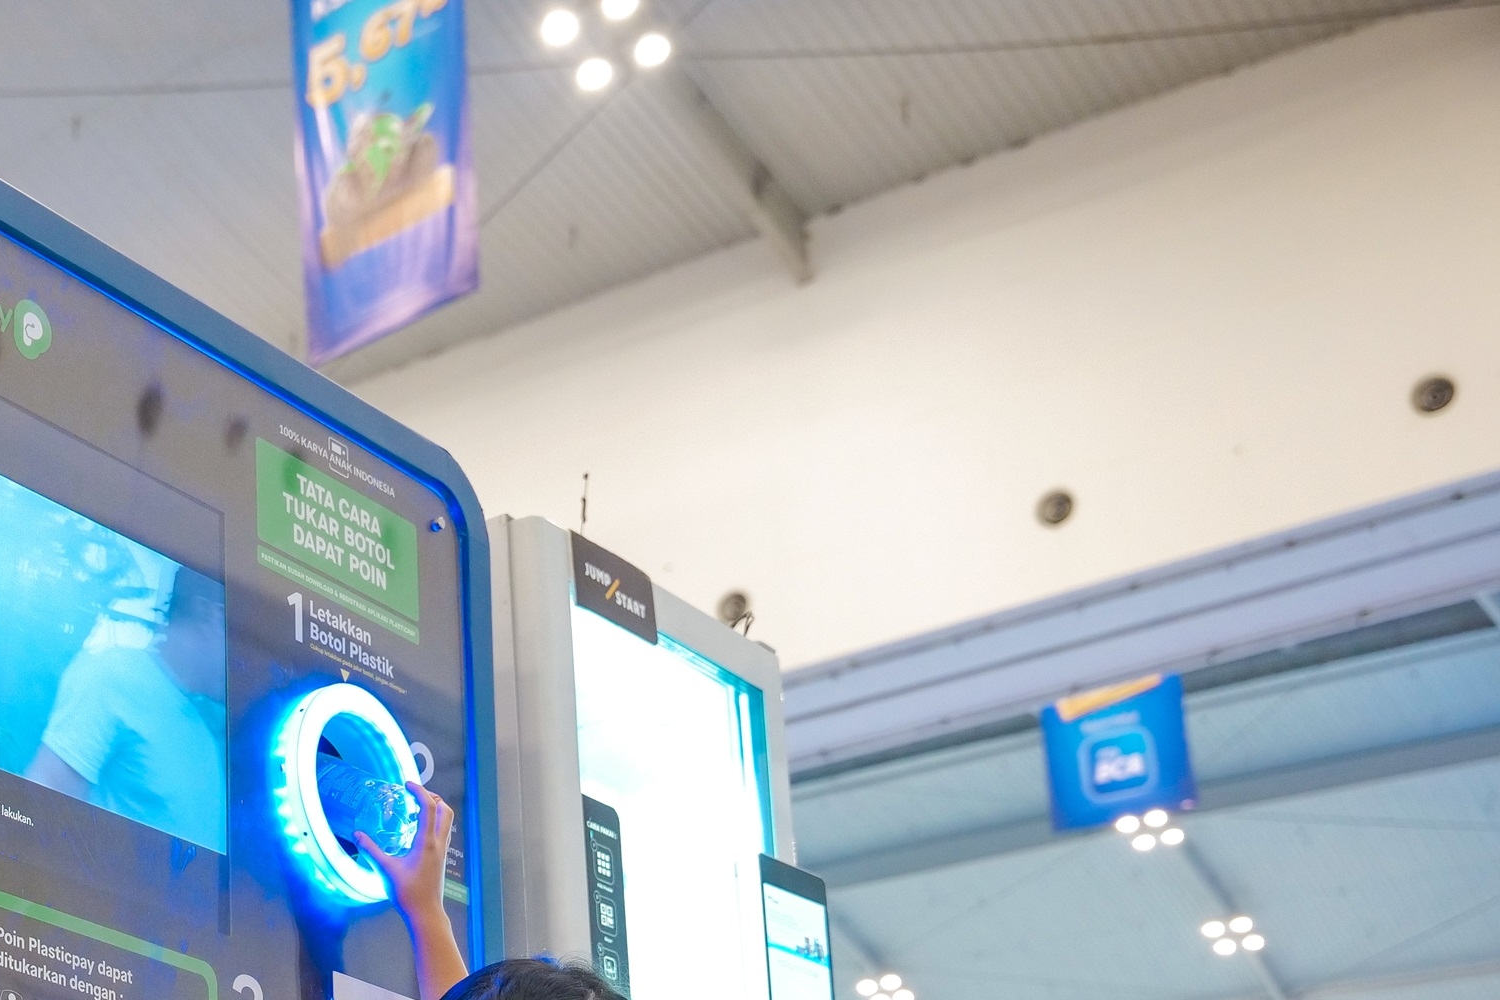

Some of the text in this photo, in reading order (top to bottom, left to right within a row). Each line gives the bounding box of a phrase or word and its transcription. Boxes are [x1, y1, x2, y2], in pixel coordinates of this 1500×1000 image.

[280, 425, 395, 498] 100% KARYA ANAK INDONESIA
[283, 492, 395, 570] TUKAR BOTOL
[297, 473, 382, 538] TATA CARA
[294, 523, 387, 590] DAPAT POIN
[287, 592, 371, 645] 1 Letakkan
[584, 562, 646, 619] JUMP START
[310, 622, 394, 678] Botol Plastik
[1, 804, 34, 827] lakukan.
[28, 936, 95, 975] Plasticpay
[98, 960, 133, 984] dapat
